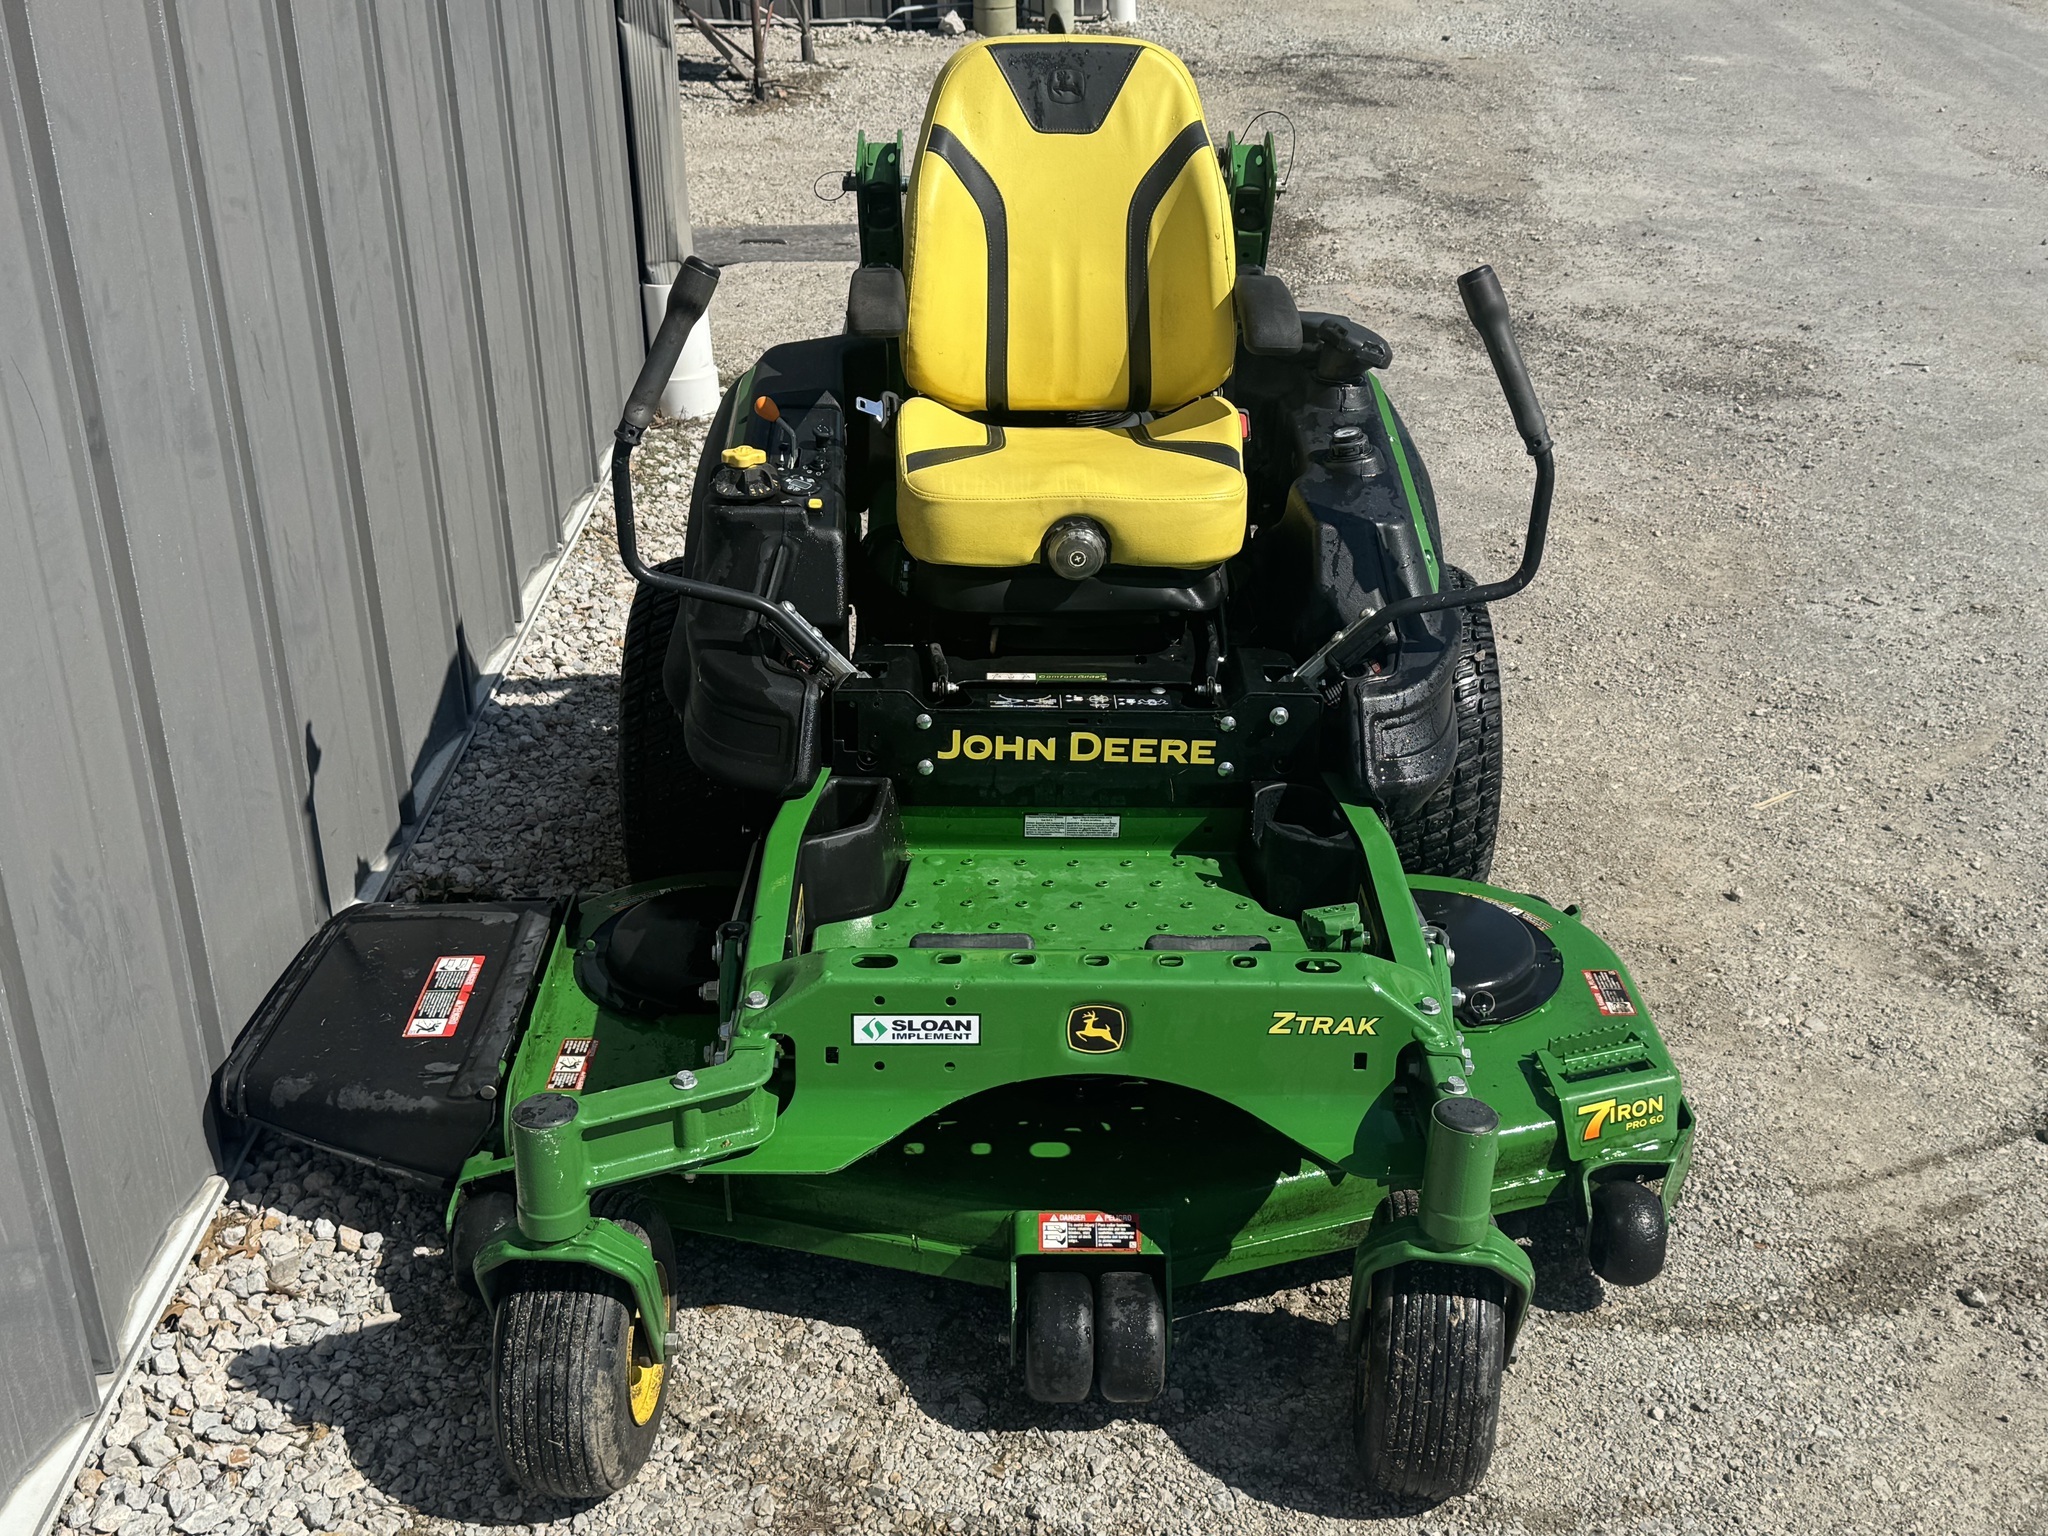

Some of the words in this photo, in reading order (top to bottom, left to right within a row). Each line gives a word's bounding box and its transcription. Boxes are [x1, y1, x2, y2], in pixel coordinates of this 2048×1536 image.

[937, 729, 1056, 761] JOHN
[1069, 731, 1217, 765] DEERE
[891, 1019, 972, 1032] SLOAN
[1267, 1011, 1380, 1036] ZTRAK
[891, 1032, 972, 1040] IMPLEMENT
[1625, 1118, 1648, 1131] PRO
[1649, 1114, 1665, 1125] 60
[1104, 1214, 1132, 1222] PELIGRO
